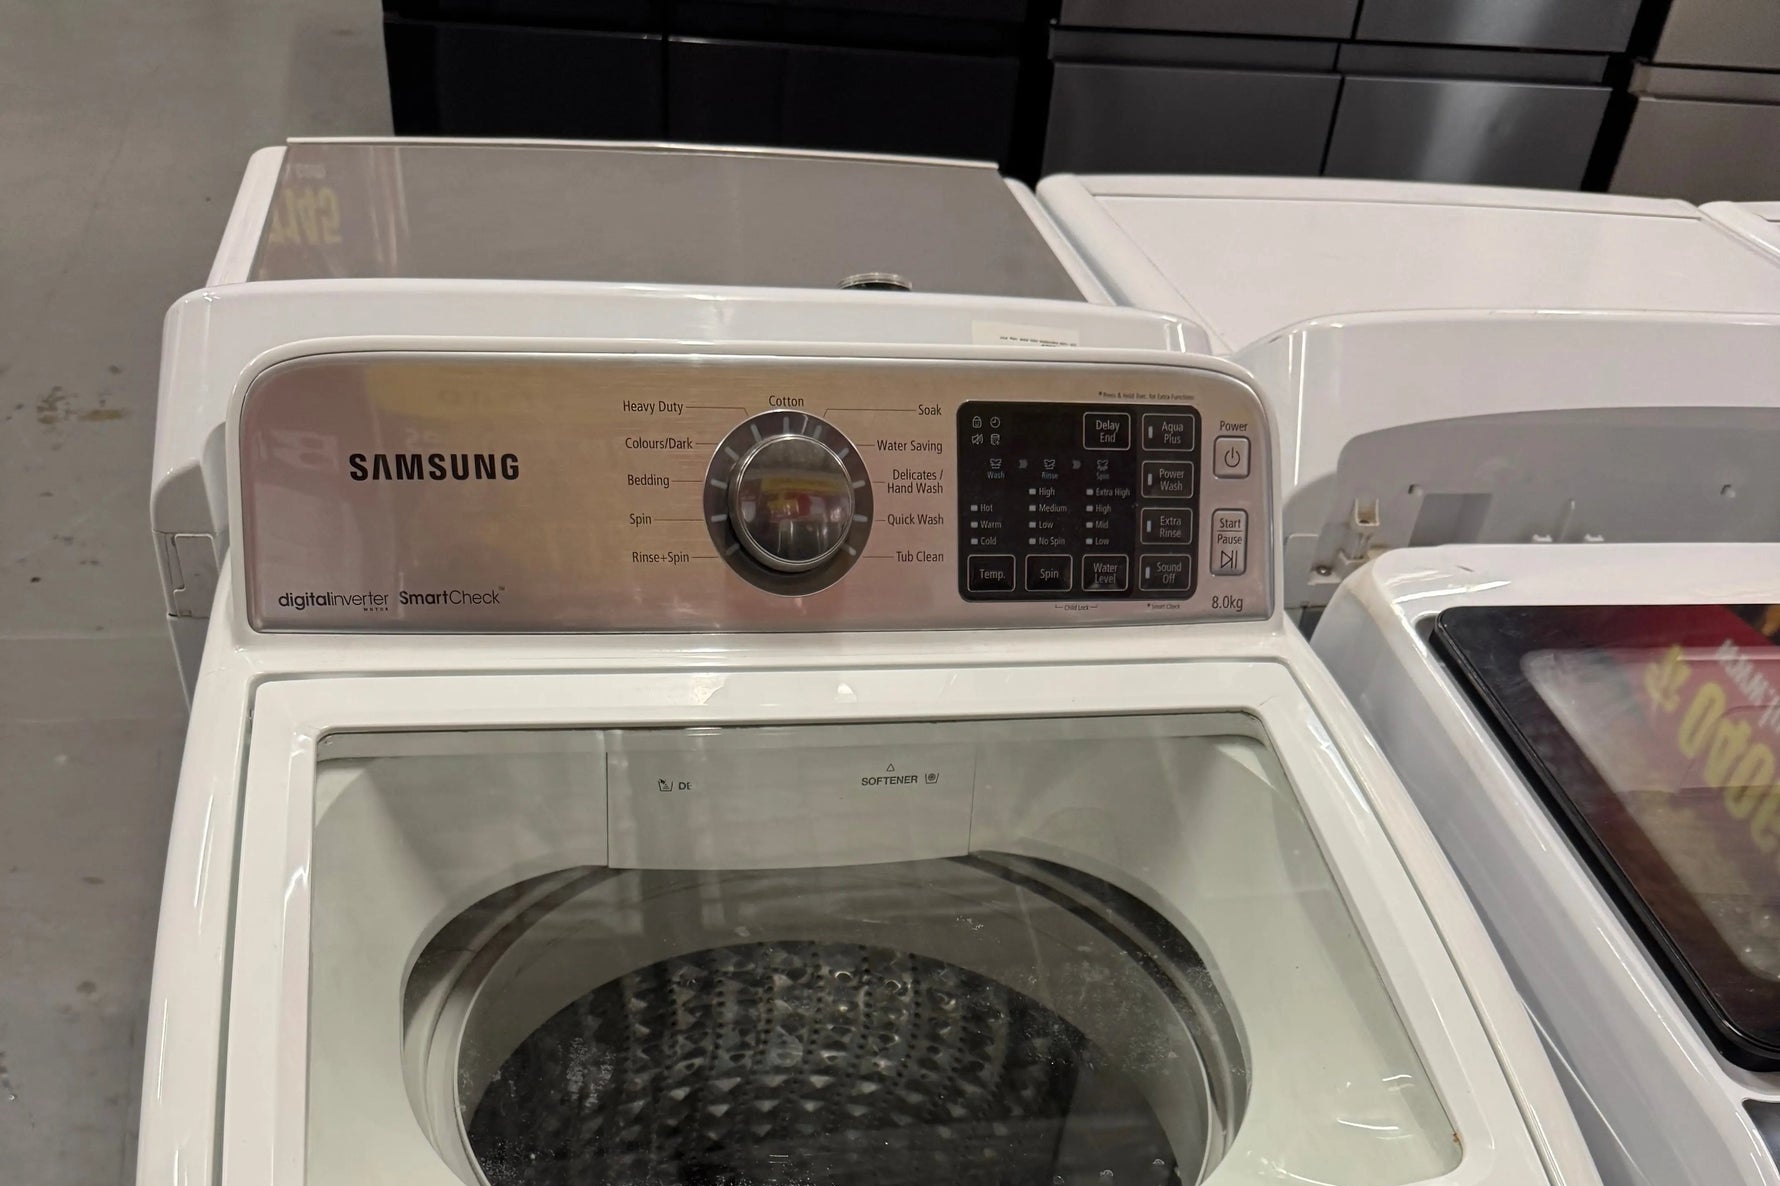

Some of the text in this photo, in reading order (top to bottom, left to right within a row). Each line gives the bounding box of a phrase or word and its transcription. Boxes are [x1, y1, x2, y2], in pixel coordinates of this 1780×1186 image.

[768, 395, 805, 408] Cotton
[623, 401, 684, 414] Heavy Duty
[918, 404, 942, 416] Soak
[1095, 420, 1120, 433] Delay
[1161, 421, 1184, 434] Aqua
[1219, 421, 1248, 432] Power
[1099, 432, 1116, 443] End
[1163, 434, 1181, 444] Plus
[625, 437, 693, 450] Colours/Dark
[876, 440, 943, 454] Water Saving
[350, 453, 519, 481] SAMSUNG
[892, 469, 938, 481] Delicates
[986, 471, 1005, 479] Wash
[1041, 471, 1059, 480] Rinse
[1096, 472, 1110, 481] Spin
[1159, 468, 1184, 479] Power
[627, 475, 670, 489] Bedding
[1160, 480, 1183, 491] Wash
[887, 482, 944, 495] Hand Wash
[1039, 487, 1055, 498] High
[1095, 487, 1130, 498] Extra High
[980, 503, 993, 512] Hot
[1038, 503, 1067, 512] Medium
[1095, 504, 1112, 514] High
[629, 513, 652, 527] Spin
[887, 513, 944, 526] Quick Wash
[980, 520, 1002, 529] Warm
[1039, 520, 1054, 529] Low
[1095, 520, 1109, 529] Mid
[1160, 516, 1182, 527] Extra
[1219, 517, 1241, 529] Start
[1159, 528, 1182, 539] Rinse
[980, 537, 997, 546] Cold
[1038, 537, 1066, 547] No Spin
[1095, 537, 1109, 546] Low
[1217, 534, 1242, 545] Pause
[632, 552, 690, 565] Rinse+Spin
[896, 550, 944, 563] Tub Clean
[1093, 563, 1118, 574] Water
[1156, 561, 1182, 573] Sound
[979, 568, 1006, 582] Temp.
[1040, 568, 1059, 581] Spin
[1094, 573, 1116, 585] Level
[1162, 573, 1176, 584] Off
[1211, 596, 1243, 612] 8.0kg
[861, 775, 918, 787] SOFTENER
